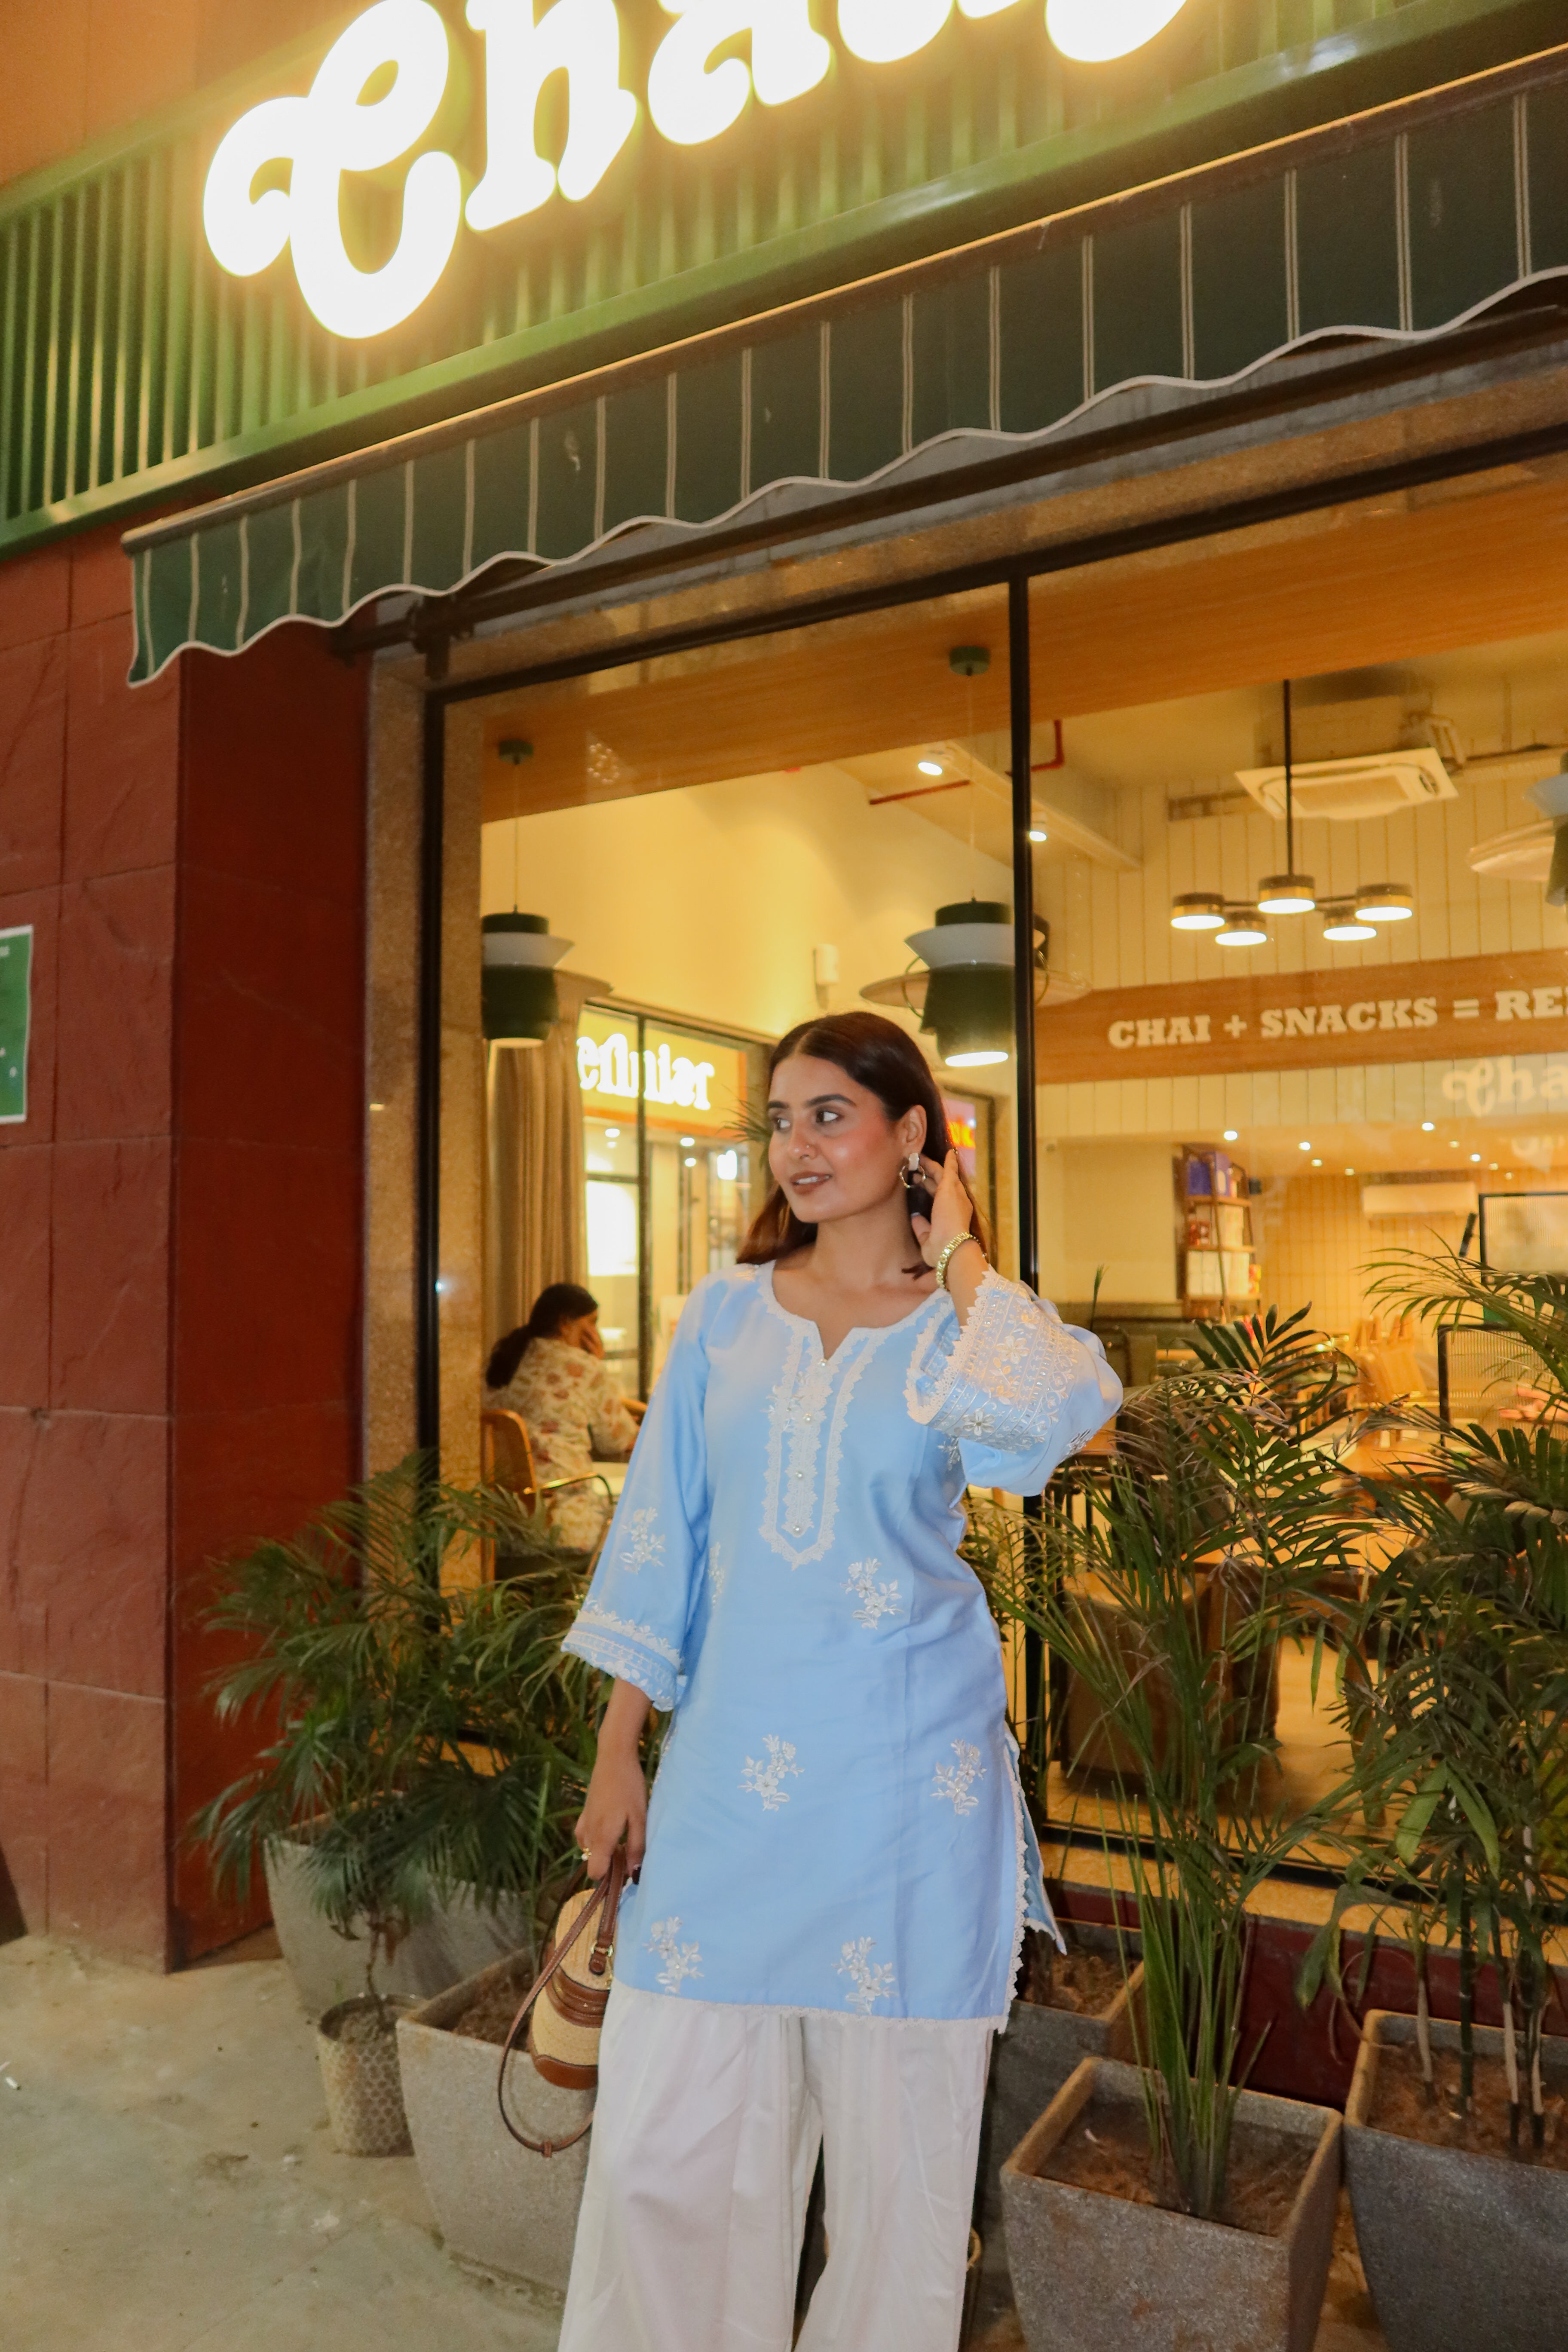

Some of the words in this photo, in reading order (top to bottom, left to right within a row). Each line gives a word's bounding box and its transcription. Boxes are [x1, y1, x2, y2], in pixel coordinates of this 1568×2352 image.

[1109, 1015, 1211, 1048] CHAI
[1225, 1015, 1247, 1038] +
[1260, 996, 1438, 1038] SNACKS
[1494, 986, 1568, 1021] RE
